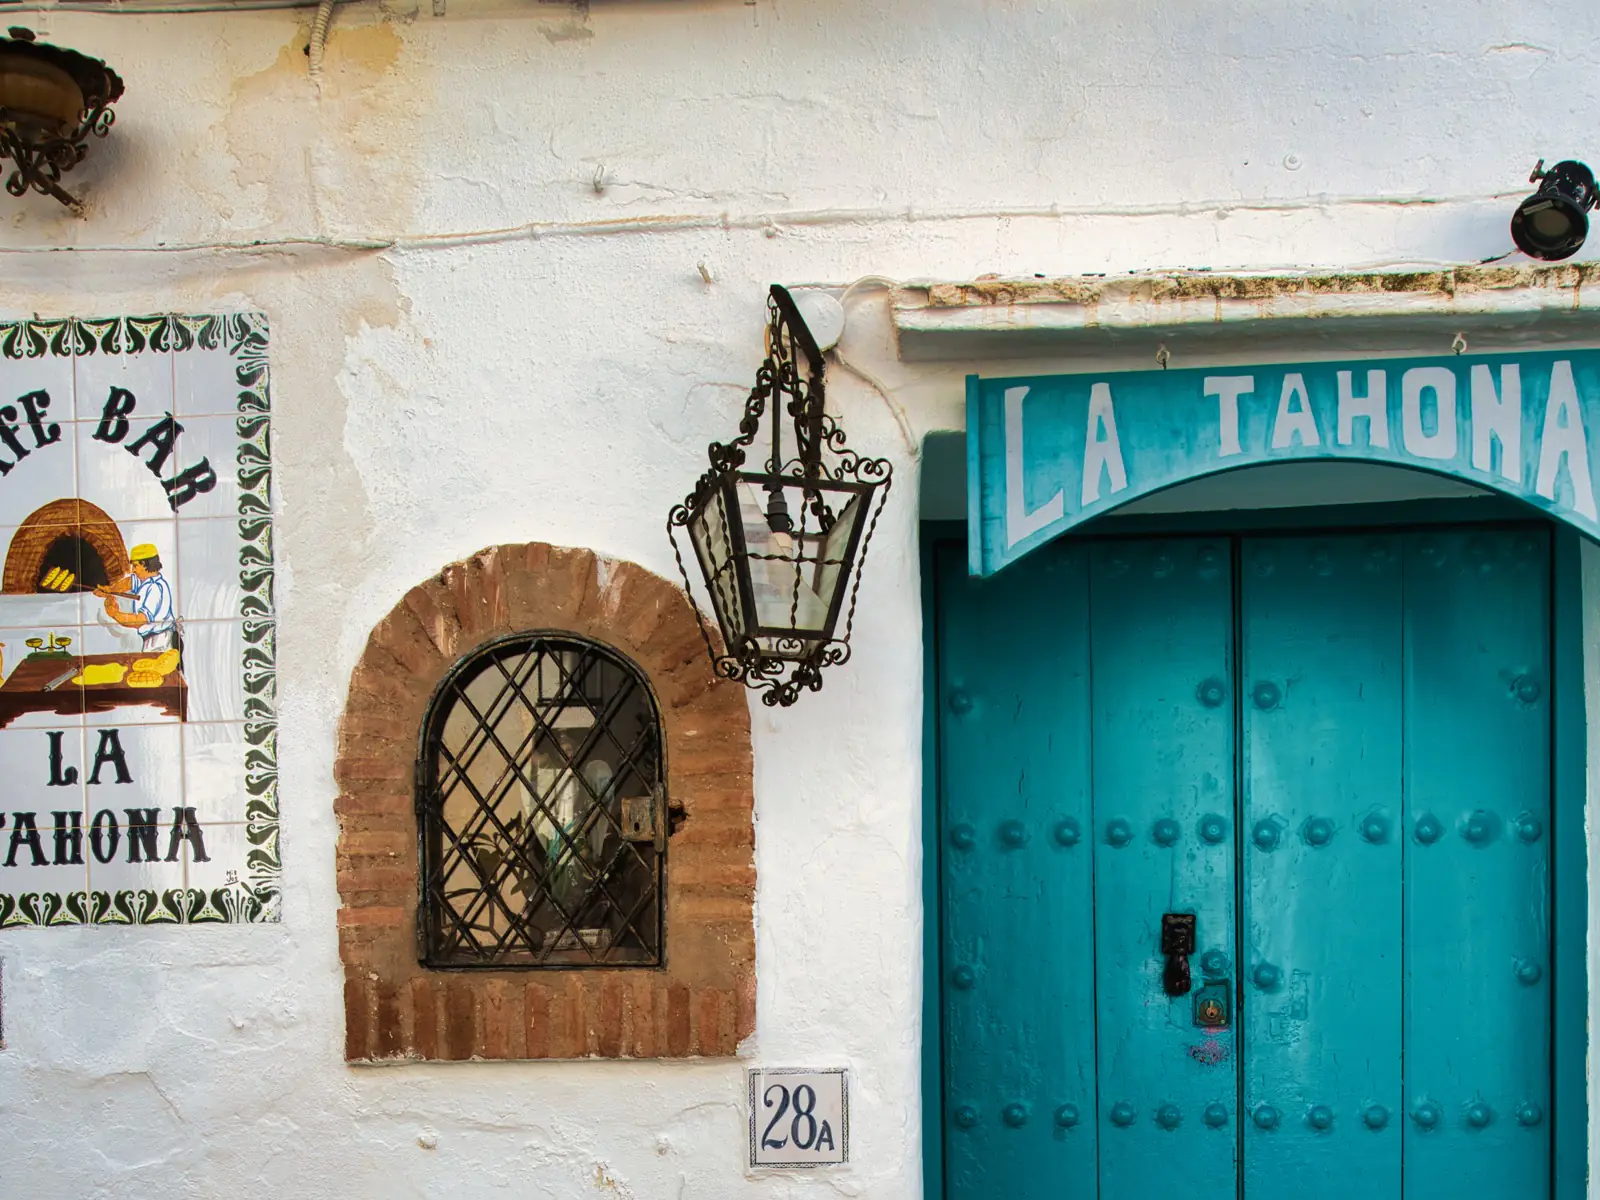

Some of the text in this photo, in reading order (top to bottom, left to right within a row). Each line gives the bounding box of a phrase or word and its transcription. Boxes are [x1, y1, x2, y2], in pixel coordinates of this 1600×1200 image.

[0, 385, 217, 514] FE BAR
[1004, 361, 1598, 551] LA TAHONA
[46, 729, 134, 786] LA
[0, 807, 211, 867] AHONA
[761, 1084, 835, 1152] 28A
